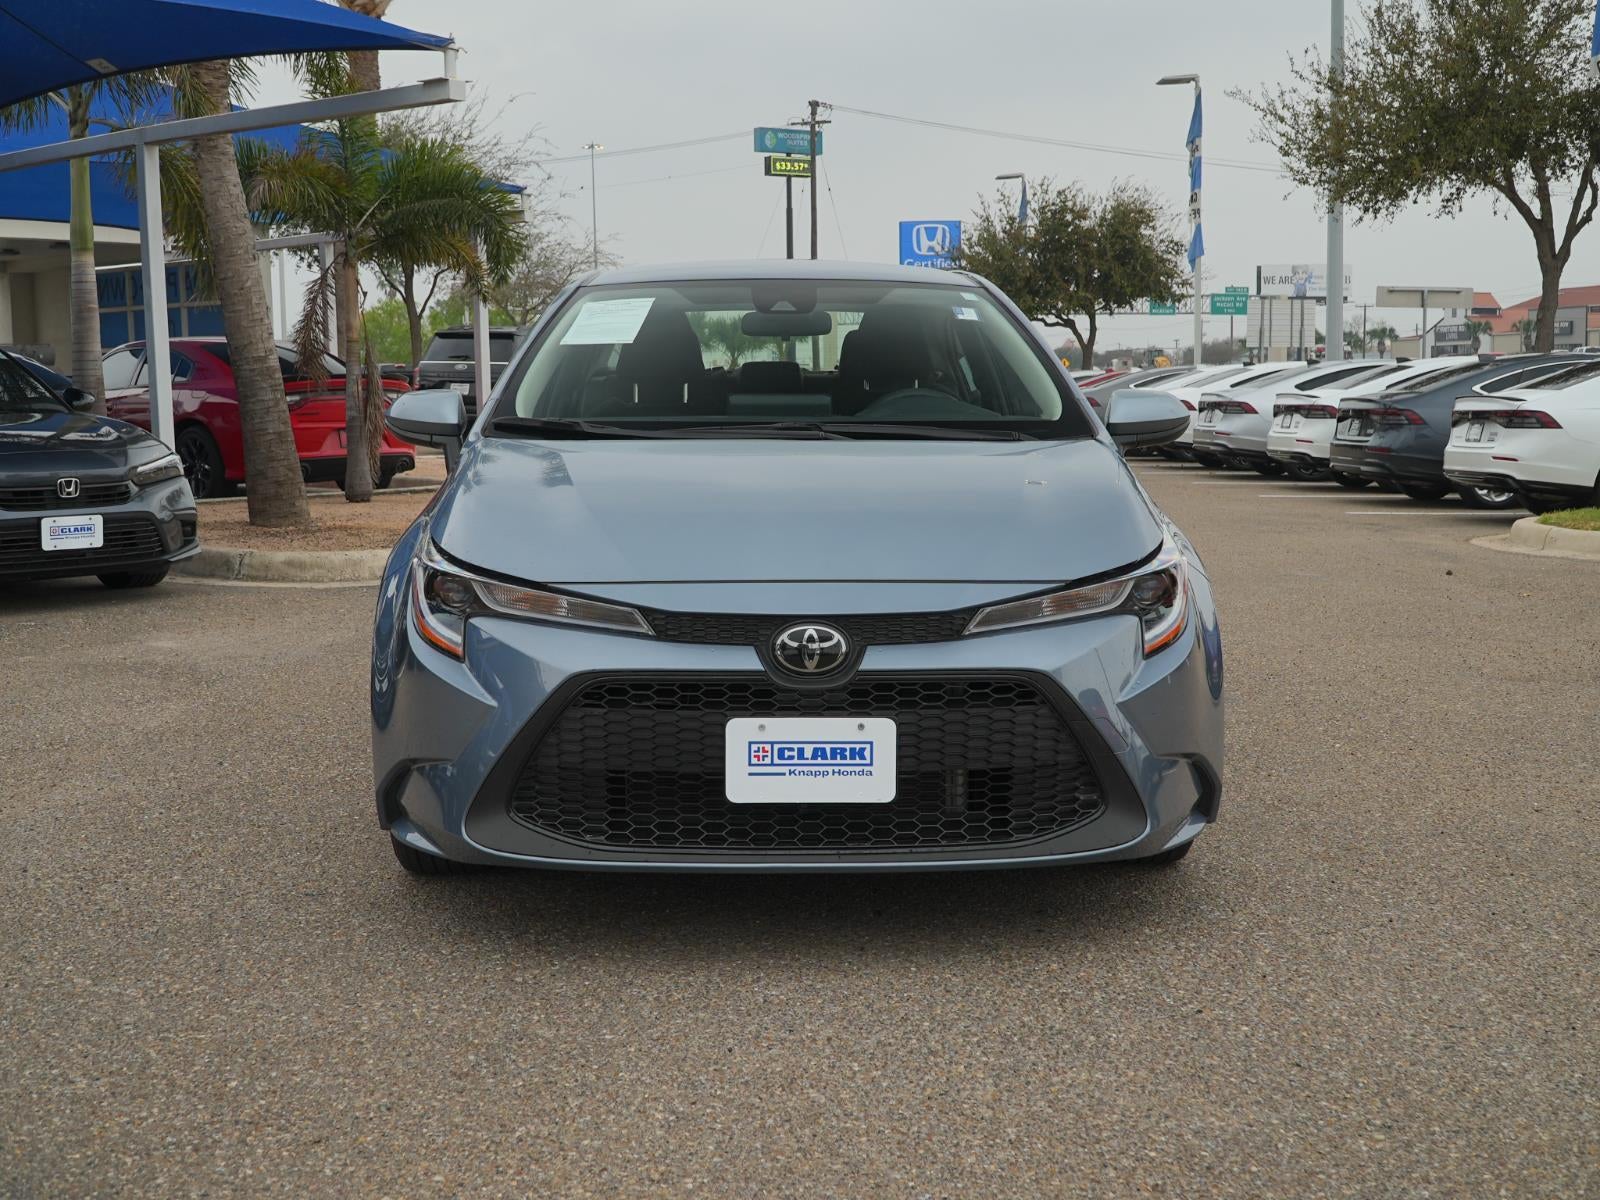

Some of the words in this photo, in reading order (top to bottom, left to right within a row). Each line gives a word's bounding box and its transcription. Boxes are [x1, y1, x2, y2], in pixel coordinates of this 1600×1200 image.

[1263, 275, 1276, 285] WE
[1278, 275, 1296, 285] ARE
[60, 526, 93, 534] CLARK
[777, 746, 867, 761] CLARK
[788, 768, 830, 778] Knapp
[832, 768, 873, 777] Honda
